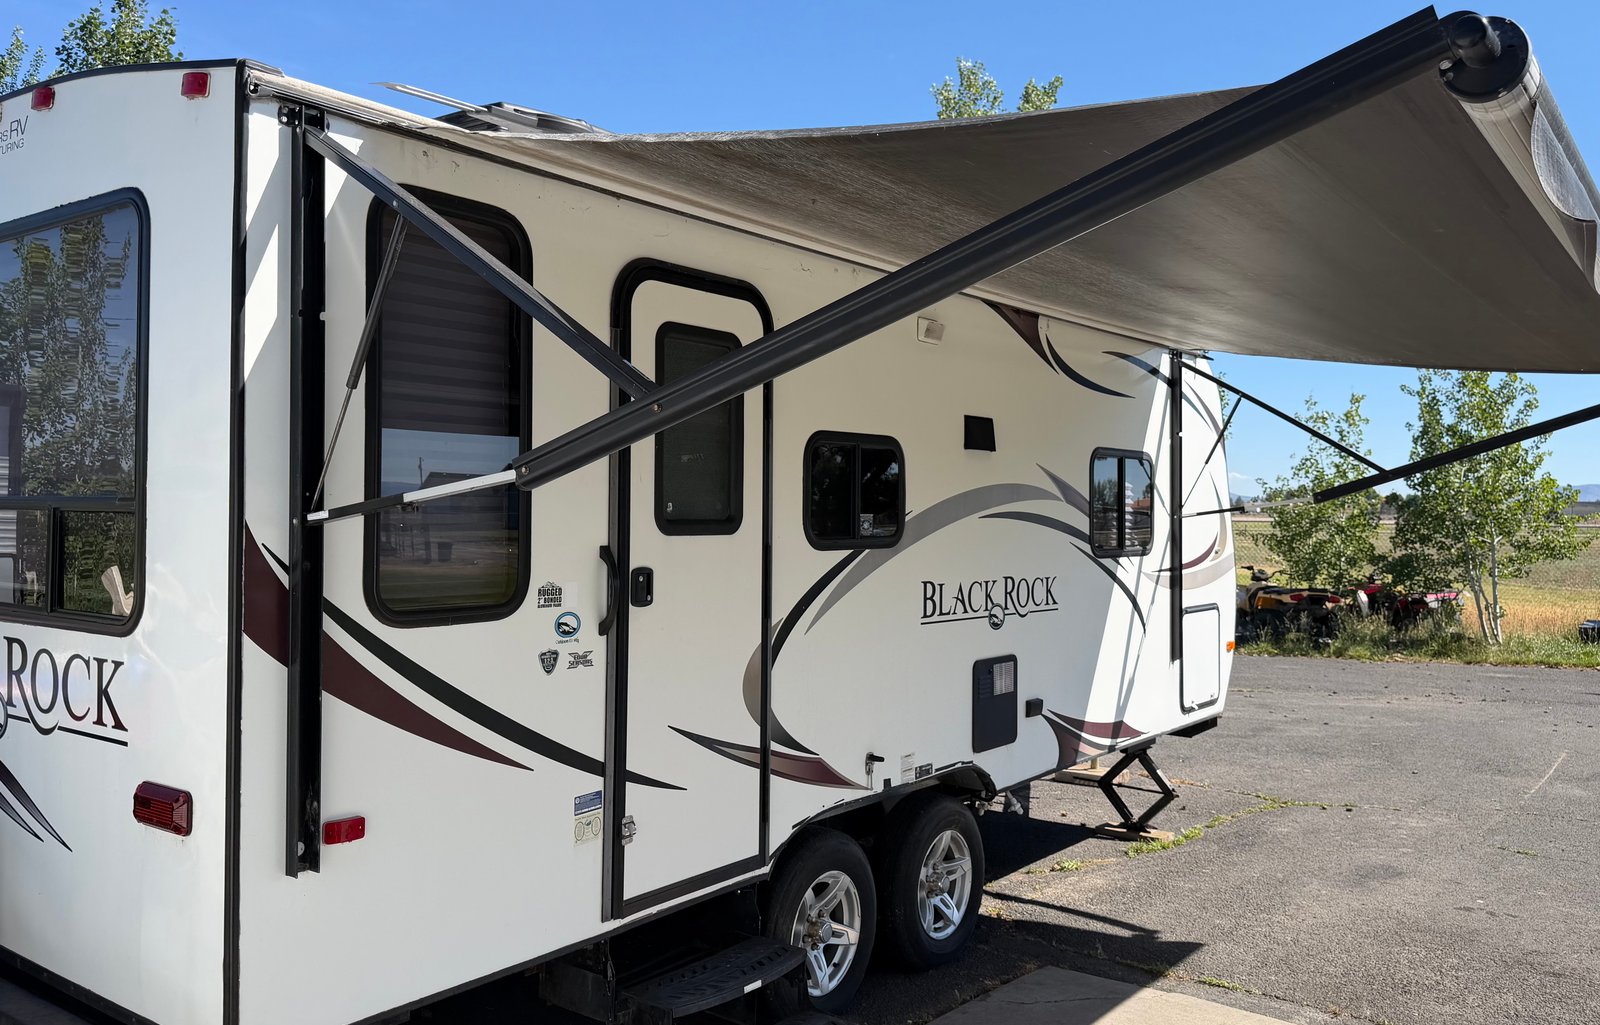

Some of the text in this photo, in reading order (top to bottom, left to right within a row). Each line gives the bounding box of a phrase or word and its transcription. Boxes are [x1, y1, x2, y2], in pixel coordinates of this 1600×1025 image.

[9, 115, 29, 140] RV
[537, 587, 562, 597] RUGGED
[920, 576, 1059, 619] BLACK ROCK
[3, 636, 129, 736] ROCK
